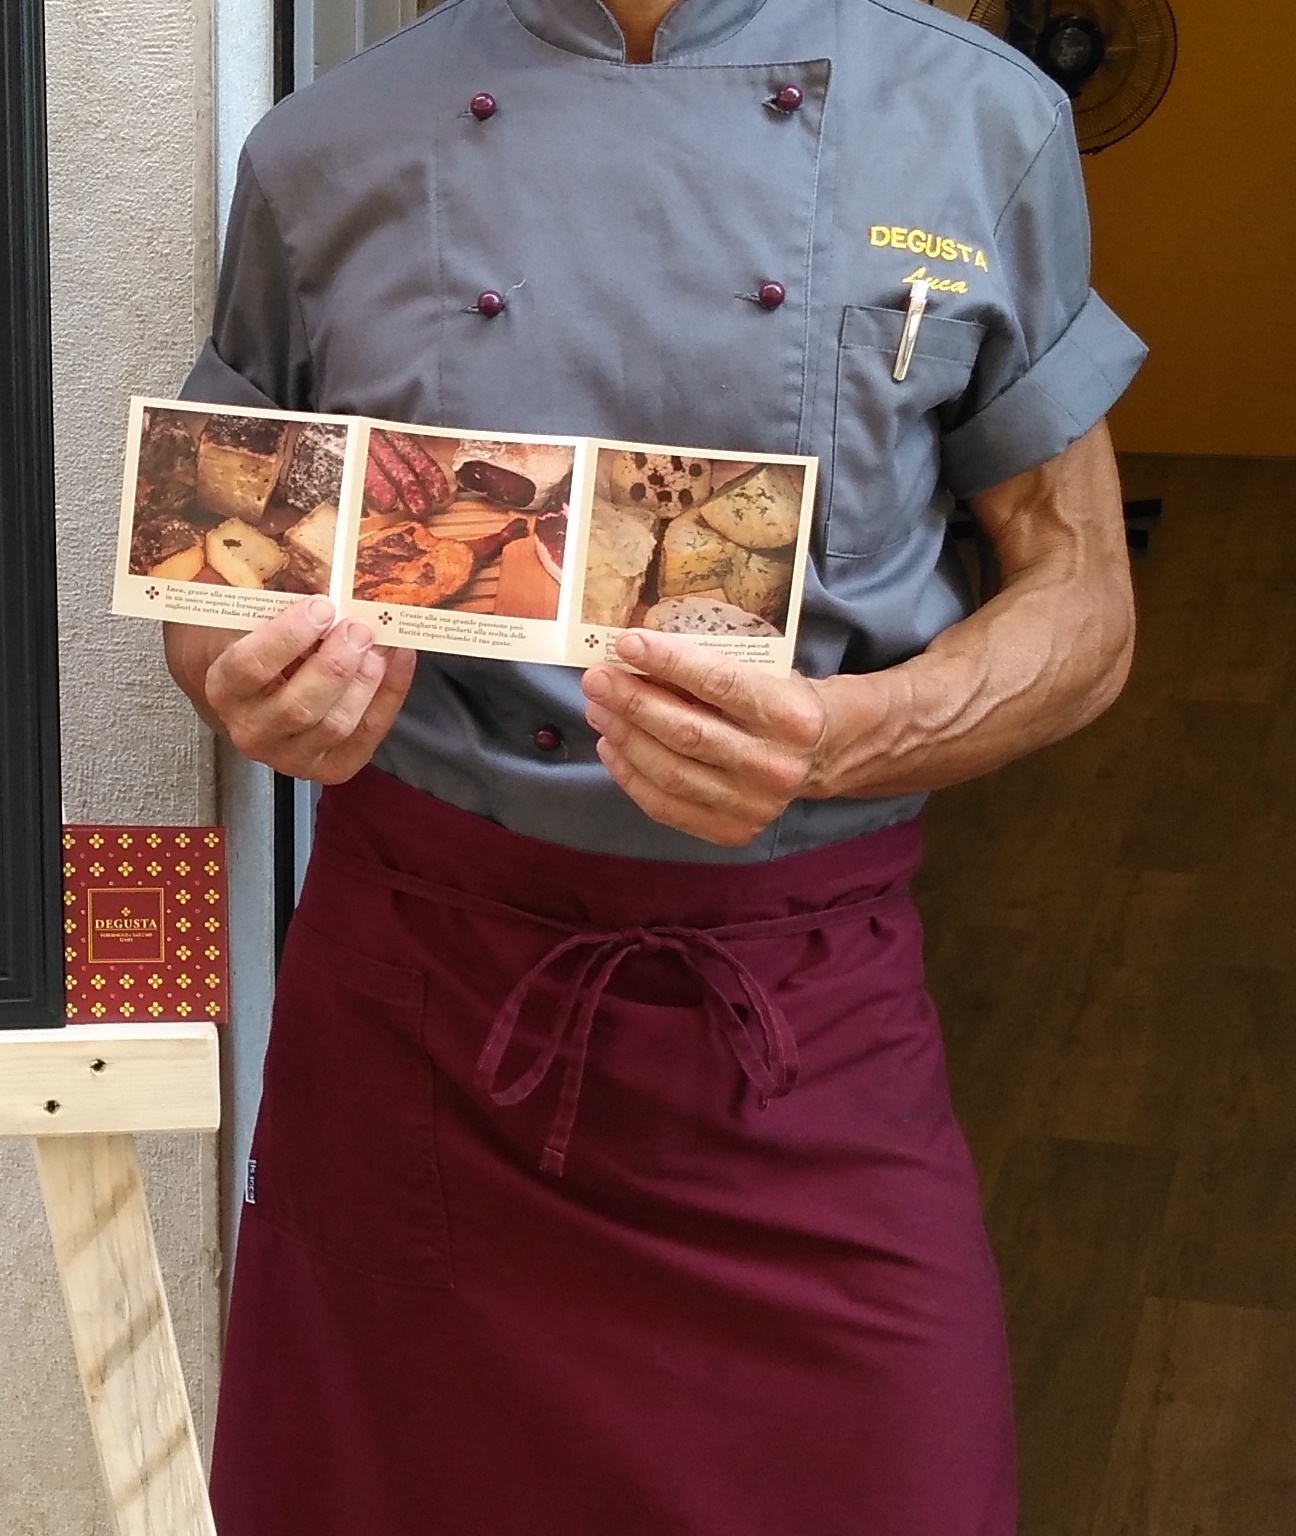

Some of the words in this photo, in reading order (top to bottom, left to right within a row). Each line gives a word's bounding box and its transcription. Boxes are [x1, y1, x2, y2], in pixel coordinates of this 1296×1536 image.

[870, 225, 988, 273] DEGUSTA
[902, 266, 969, 294] Luca
[95, 919, 158, 929] DEGUSTA
